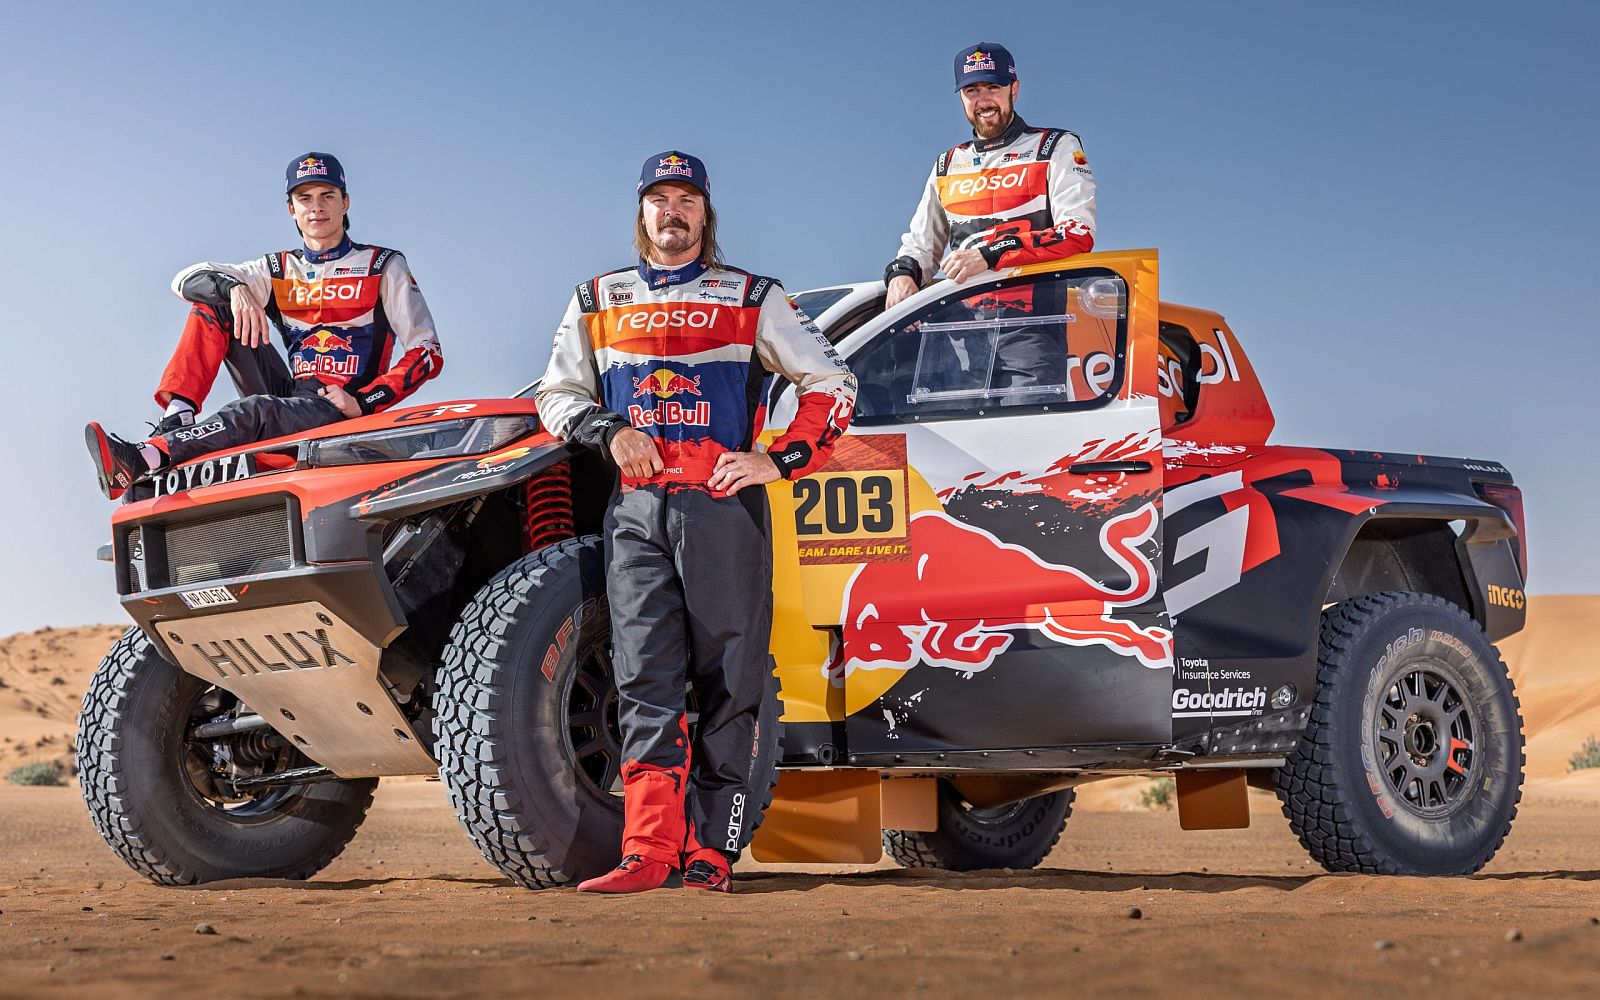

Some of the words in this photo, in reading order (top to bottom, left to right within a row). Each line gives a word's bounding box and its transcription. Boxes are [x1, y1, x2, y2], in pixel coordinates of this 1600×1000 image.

[949, 167, 1028, 197] repsol
[288, 280, 363, 305] repsol
[750, 278, 768, 302] sparco
[617, 307, 718, 333] repsol
[294, 354, 320, 375] Red
[320, 355, 359, 374] Bull
[394, 404, 477, 422] GR
[628, 401, 665, 428] Red
[666, 402, 710, 426] Bull
[175, 422, 226, 442] sparco
[153, 454, 249, 498] TOYOTA
[452, 462, 515, 481] repsol
[1463, 464, 1508, 473] HILUX
[793, 476, 894, 536] 203
[829, 546, 864, 556] DARE.
[866, 545, 892, 555] LIVE
[893, 545, 907, 554] IT.
[186, 592, 202, 607] NP
[192, 628, 356, 679] HILUX
[1180, 657, 1208, 669] Toyota
[1182, 670, 1219, 680] Insurance
[1220, 669, 1251, 679] Services
[1172, 687, 1266, 710] Goodrich
[725, 793, 745, 853] parco
